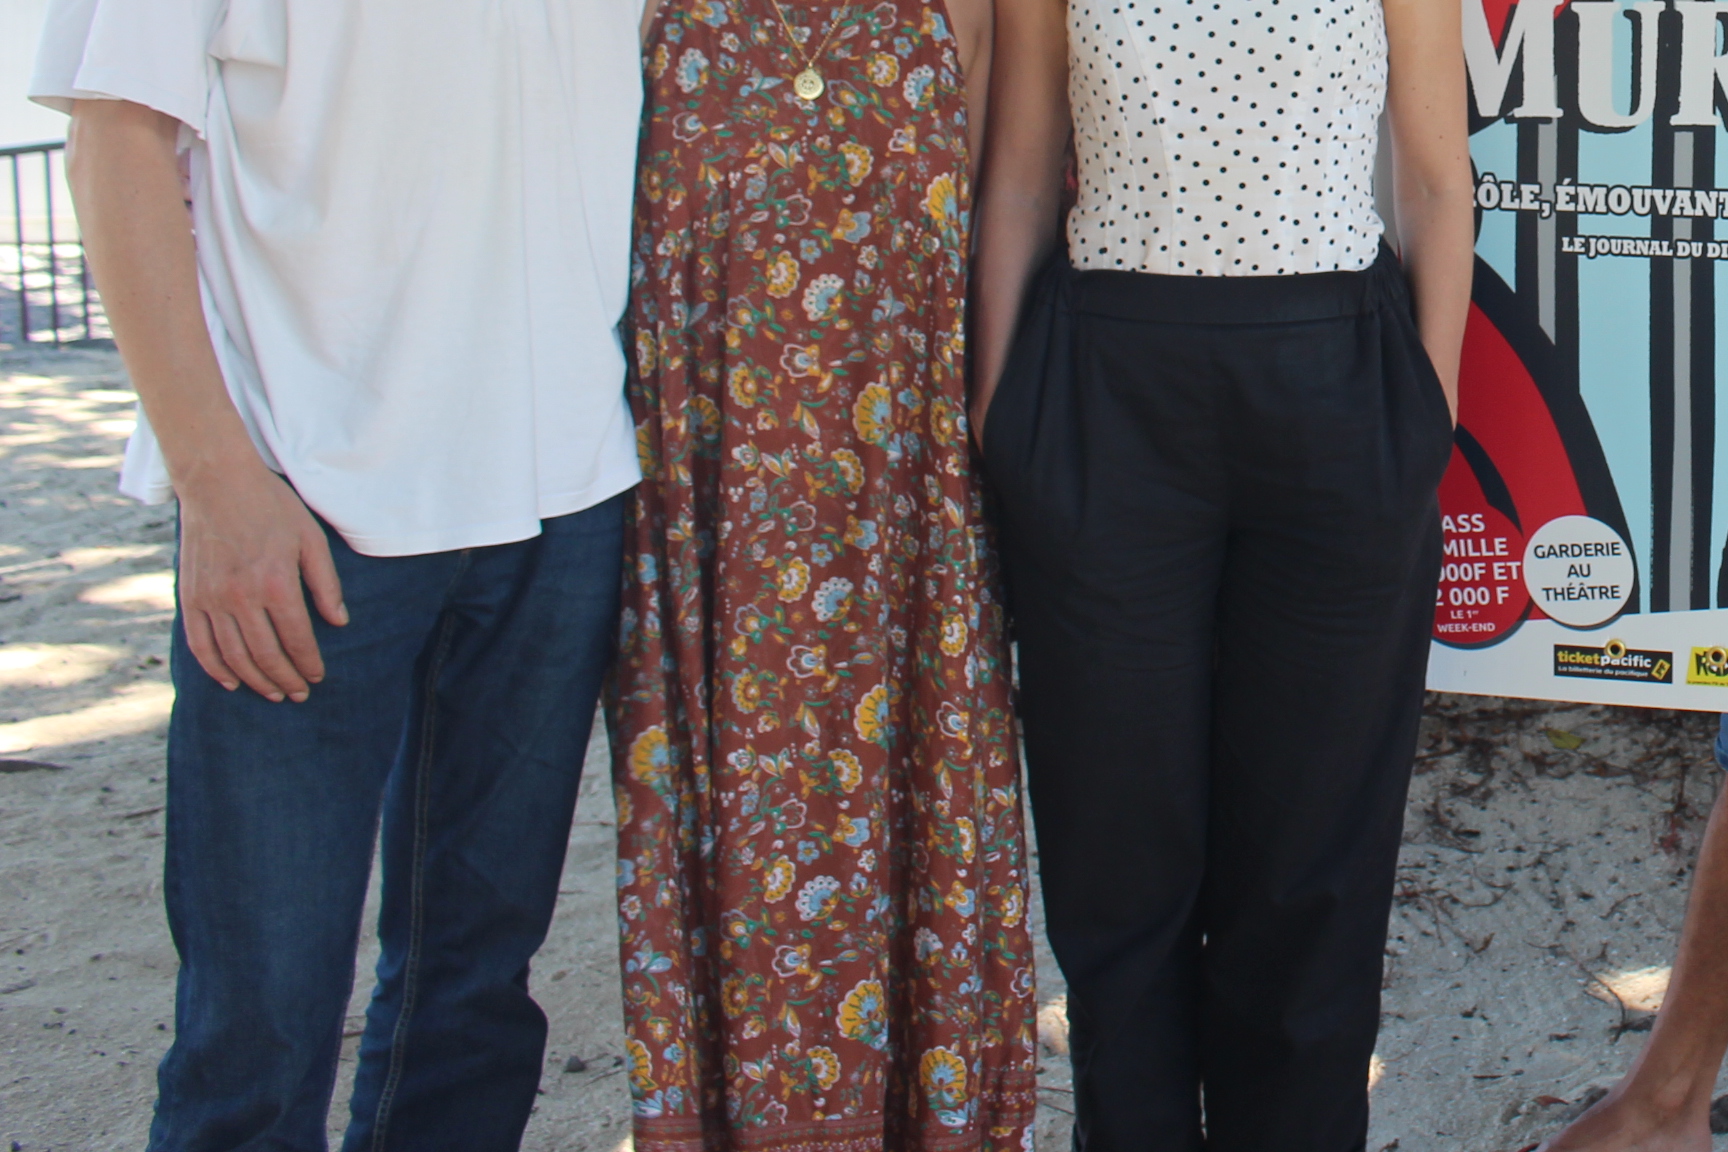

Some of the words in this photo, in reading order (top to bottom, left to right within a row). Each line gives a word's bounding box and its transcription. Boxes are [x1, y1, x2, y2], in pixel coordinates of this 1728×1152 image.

[1473, 174, 1550, 217] ÔLE,
[1562, 236, 1586, 253] LE
[1589, 237, 1674, 258] JOURNAL
[1676, 241, 1704, 258] DU
[1534, 541, 1622, 559] GARDERIE
[1493, 561, 1521, 581] ET
[1567, 564, 1592, 579] AU
[1449, 587, 1491, 606] 000
[1496, 586, 1509, 605] F
[1542, 582, 1622, 602] THÉÂTRE
[1450, 610, 1464, 619] LE
[1437, 622, 1496, 633] WEEK-END
